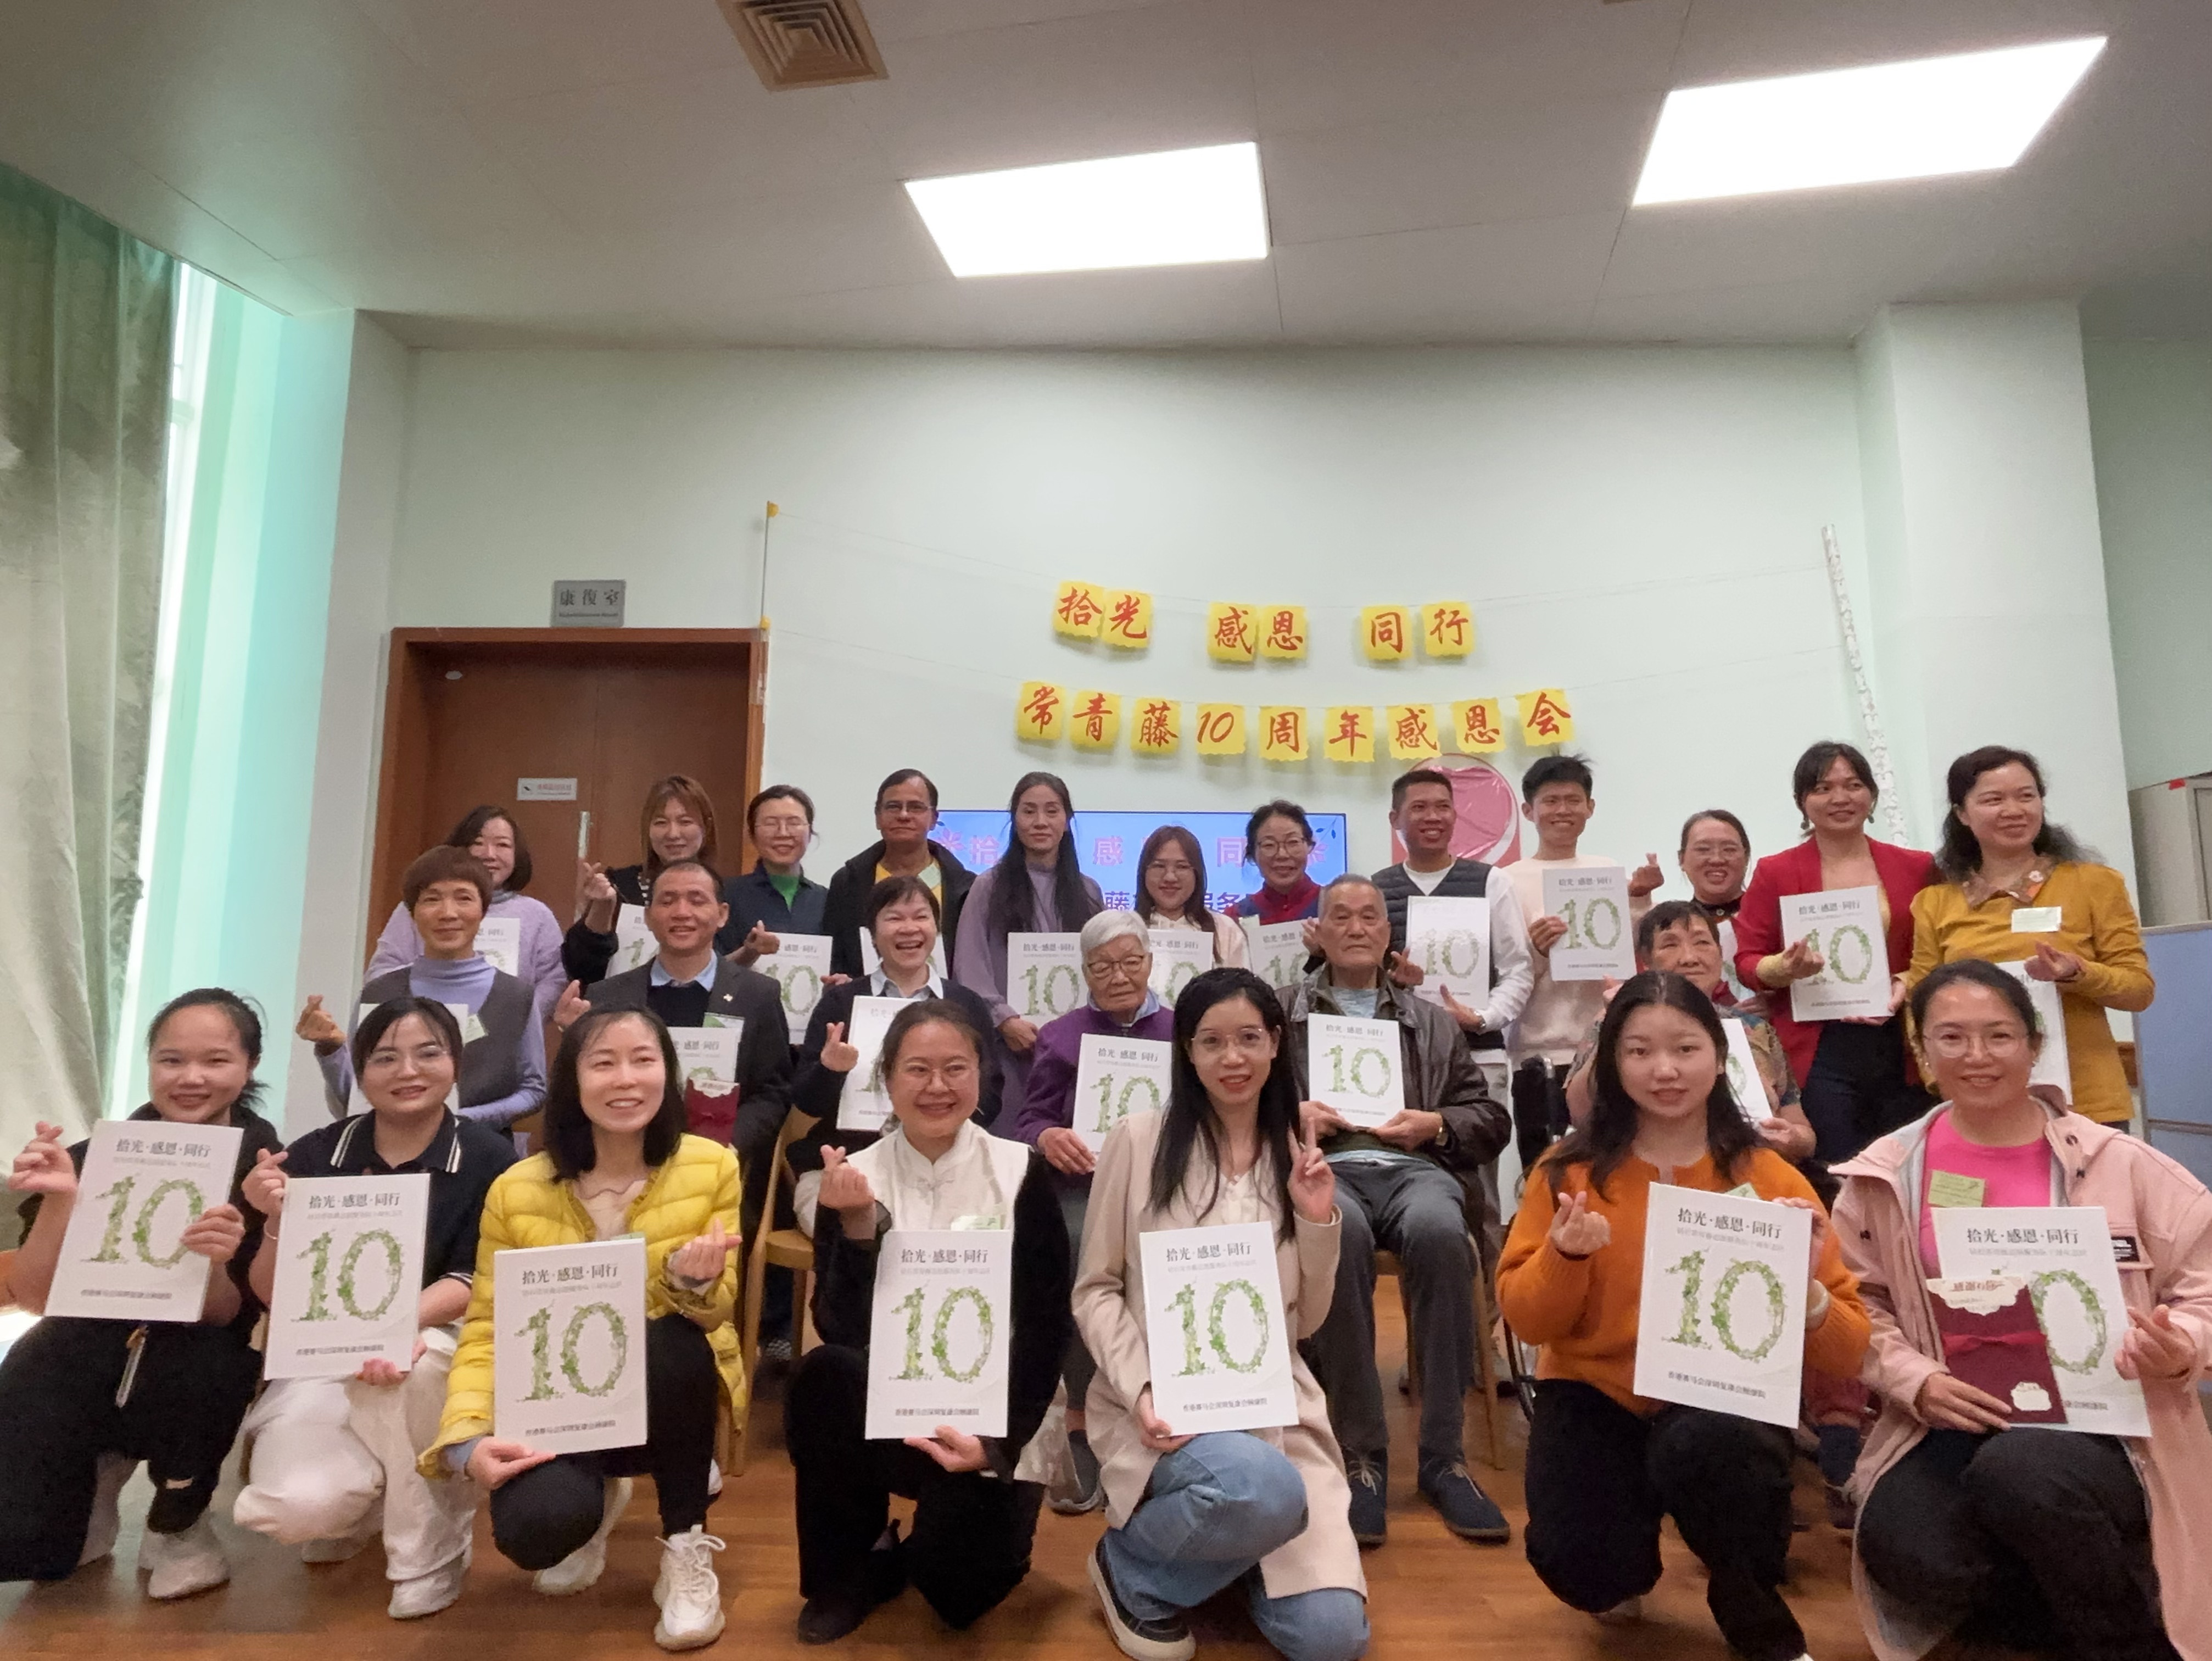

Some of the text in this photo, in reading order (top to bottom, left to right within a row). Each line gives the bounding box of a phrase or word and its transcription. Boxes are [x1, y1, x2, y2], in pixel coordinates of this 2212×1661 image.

[1059, 586, 1470, 654] 拾光 感恩 同行
[1556, 897, 1621, 950] 10
[1019, 963, 1080, 1016] 10
[1322, 1044, 1392, 1099] 10
[81, 1174, 205, 1271] 10
[291, 1228, 405, 1322] 10
[1662, 1249, 1787, 1364] 10
[514, 1299, 629, 1402] 10
[889, 1285, 995, 1384] 10
[1164, 1278, 1271, 1378] 10
